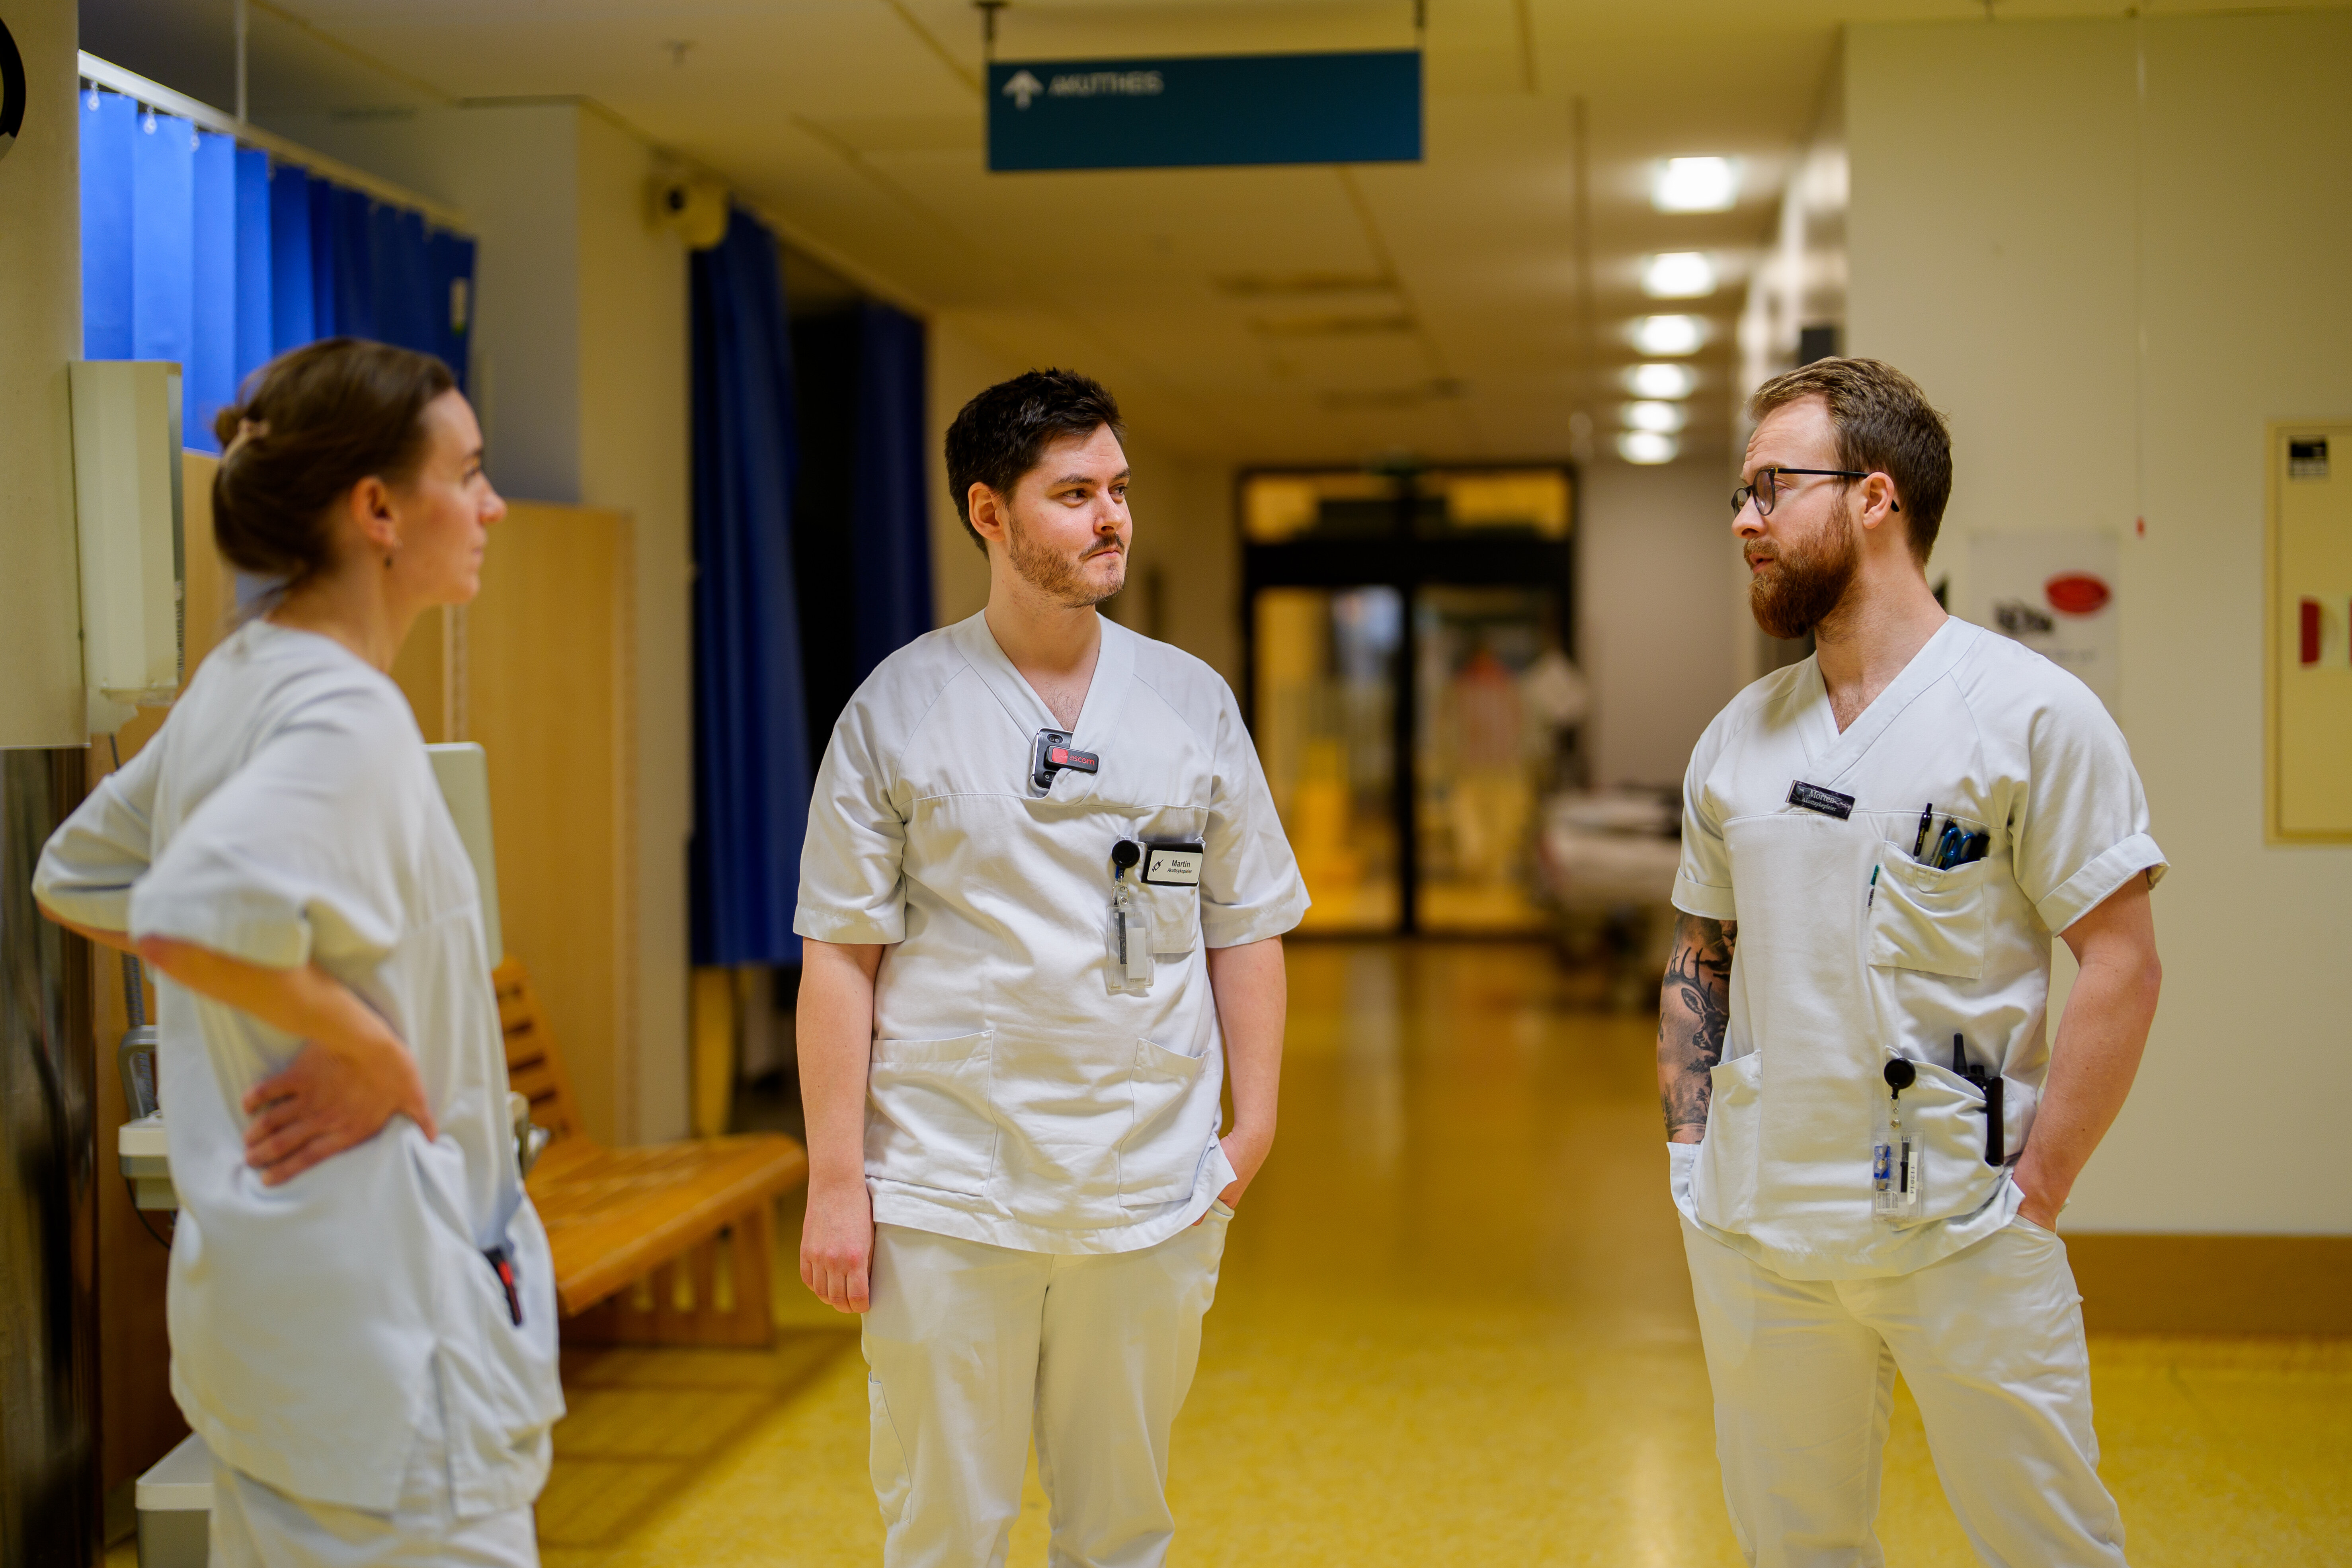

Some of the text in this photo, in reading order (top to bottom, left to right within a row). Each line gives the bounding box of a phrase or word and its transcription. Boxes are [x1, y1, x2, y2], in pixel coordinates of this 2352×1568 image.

[1069, 755, 1094, 765] ascom
[1808, 789, 1835, 803] Morten
[1802, 797, 1837, 811] Akuttsykepleier
